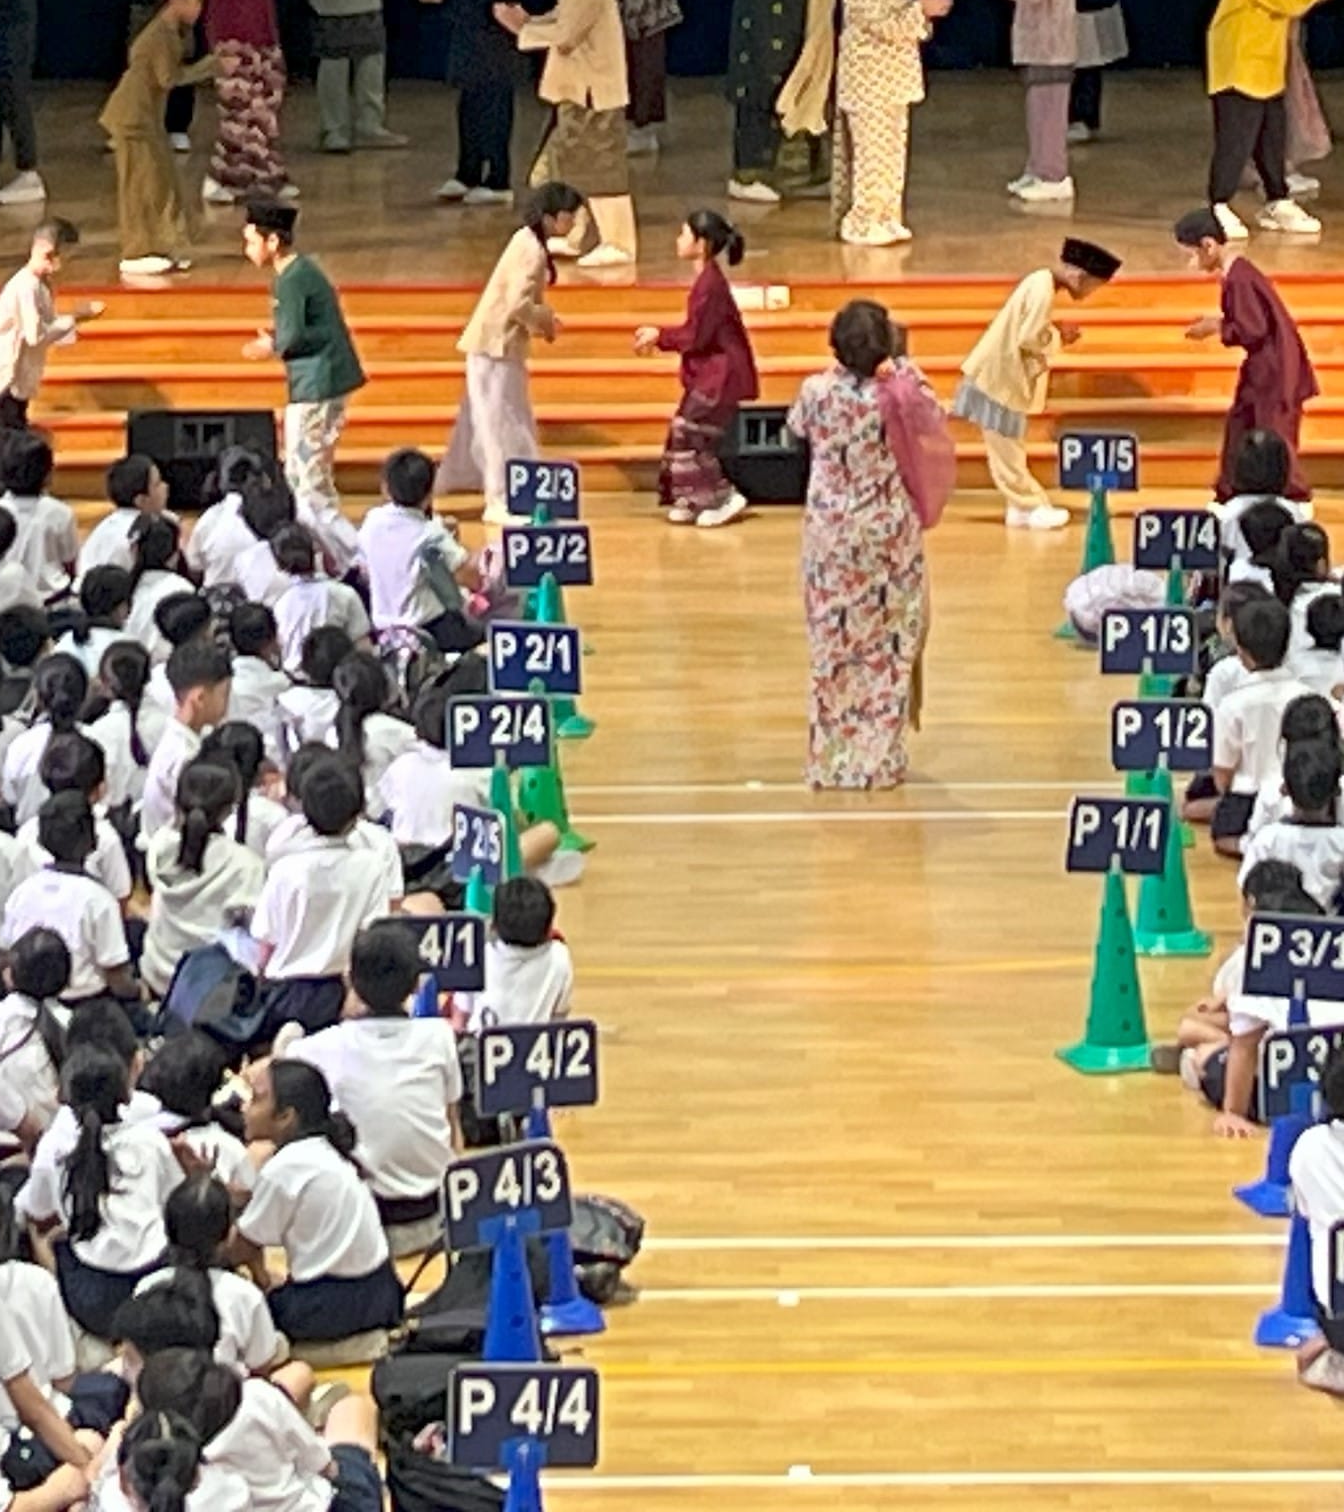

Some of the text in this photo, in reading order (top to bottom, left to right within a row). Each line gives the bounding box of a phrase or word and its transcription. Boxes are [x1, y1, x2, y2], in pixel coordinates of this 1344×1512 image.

[1062, 438, 1134, 473] P 1/5
[510, 465, 575, 501] P 2/3
[507, 533, 587, 568] P 2/2
[1139, 515, 1216, 551] P 1/4
[494, 632, 572, 673] P 2/1
[1106, 615, 1190, 653] P 1/3
[455, 704, 545, 745] P 2/4
[1117, 705, 1208, 748] P 1/2
[455, 811, 469, 851] P
[1074, 805, 1162, 851] P 1/1
[419, 922, 475, 968] 4/1
[1251, 925, 1281, 969] P
[484, 1028, 591, 1085] P 4/2
[1268, 1039, 1295, 1090] P
[447, 1150, 561, 1221] P 4/3
[460, 1377, 592, 1436] P 4/4
